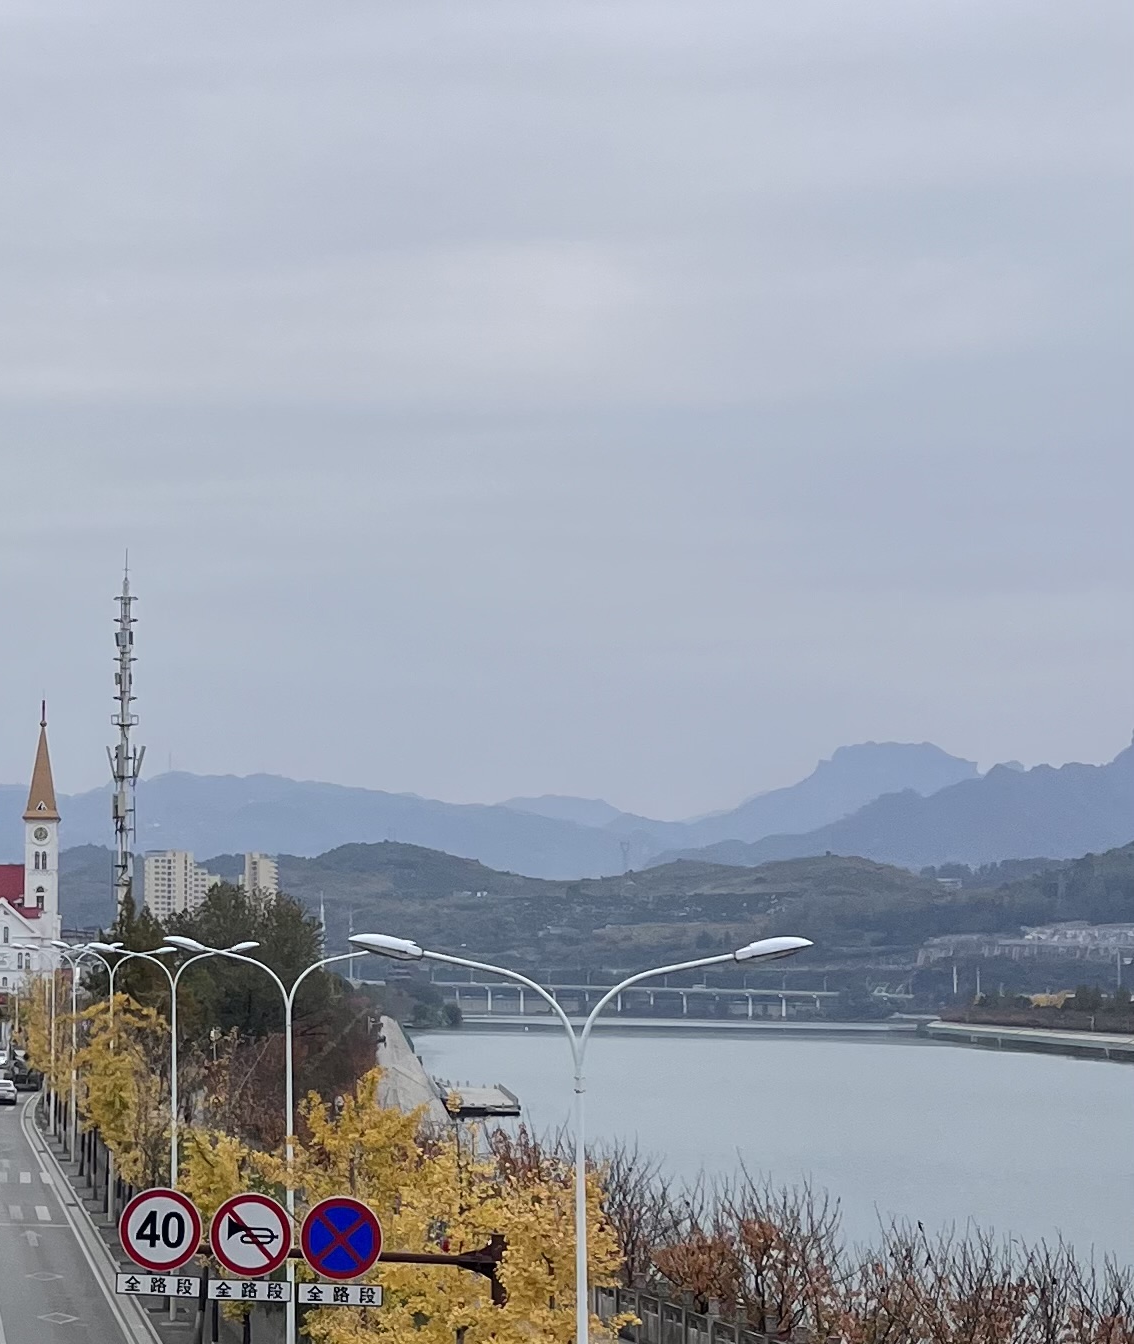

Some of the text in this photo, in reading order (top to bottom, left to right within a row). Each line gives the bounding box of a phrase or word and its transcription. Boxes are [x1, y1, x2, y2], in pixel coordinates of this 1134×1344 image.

[135, 1210, 185, 1249] 40
[124, 1275, 193, 1296] 全路段
[215, 1281, 283, 1299] 全路段
[307, 1285, 376, 1304] 全路段
